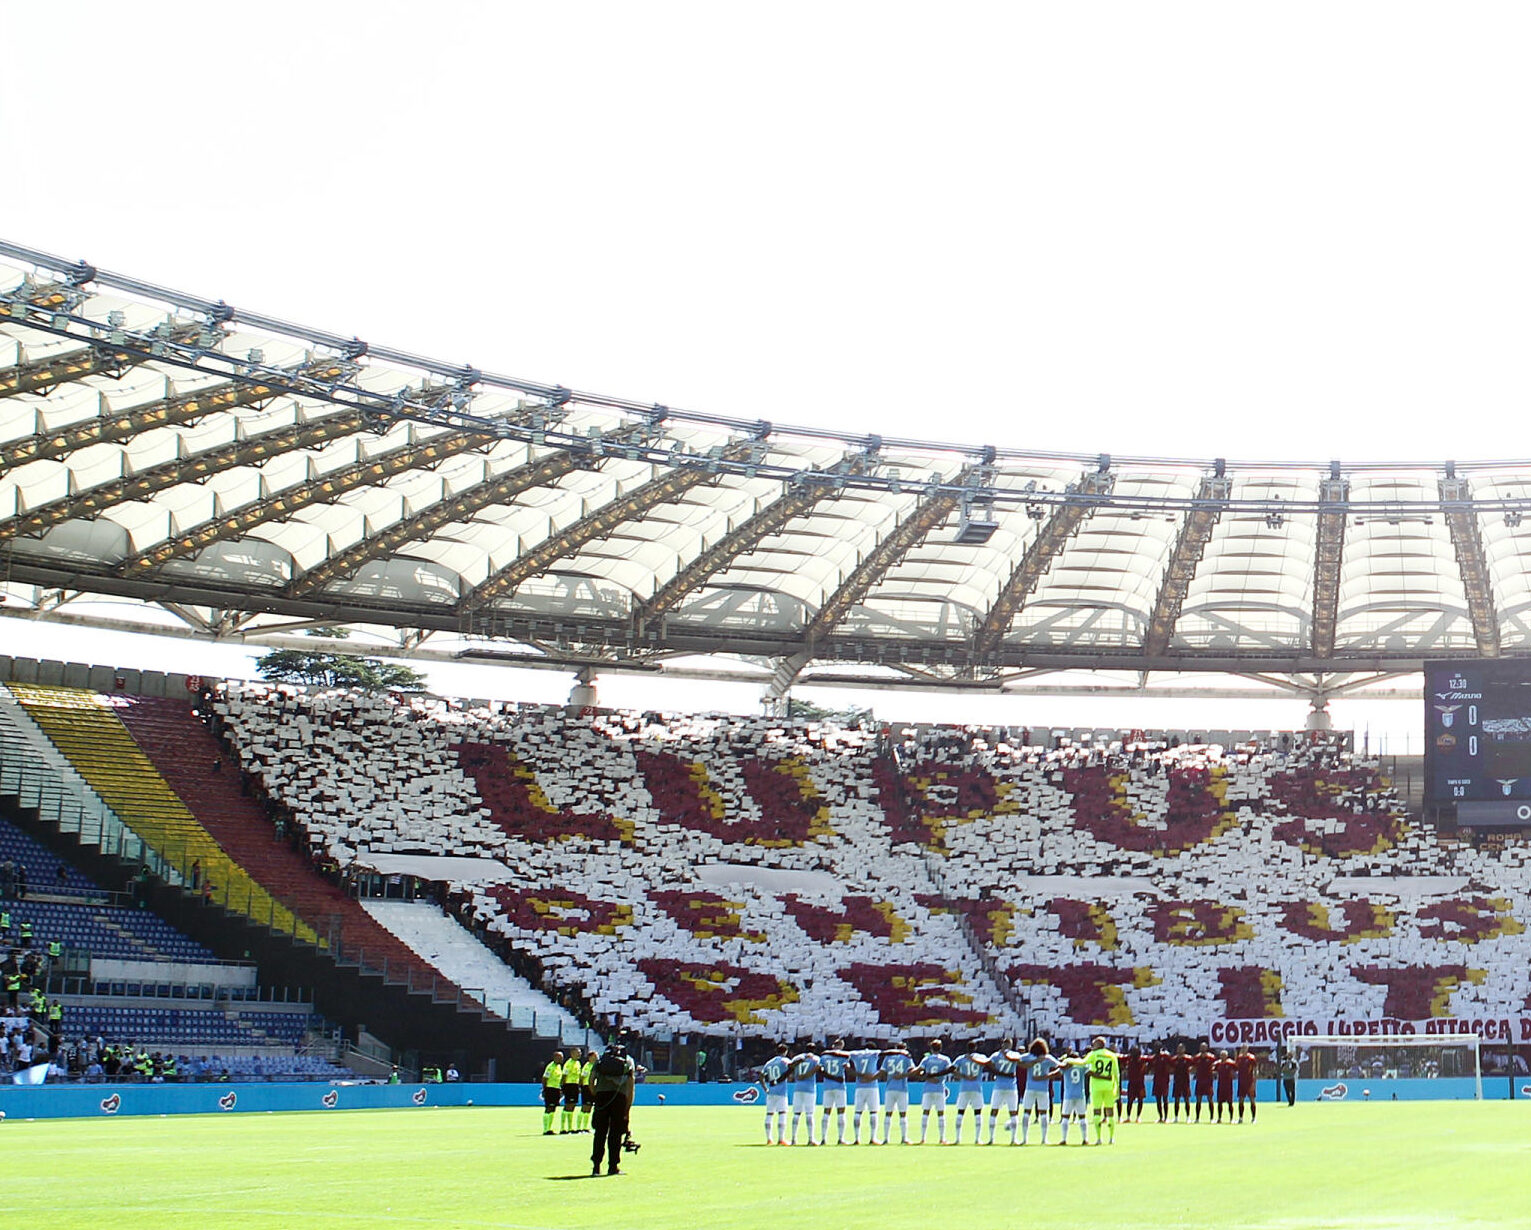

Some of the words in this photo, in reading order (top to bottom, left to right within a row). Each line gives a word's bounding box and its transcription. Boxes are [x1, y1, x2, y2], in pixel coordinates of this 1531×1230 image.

[1469, 704, 1477, 726] 0
[1469, 735, 1477, 756] 0
[450, 742, 1412, 858] LUPUS
[1211, 1020, 1318, 1043] CORAGGIO
[768, 1066, 780, 1081] 10
[826, 1059, 839, 1074] 13
[861, 1058, 869, 1073] 7
[887, 1059, 905, 1075] 34
[965, 1062, 980, 1076] 19
[1033, 1062, 1042, 1076] 8
[1095, 1059, 1113, 1076] 94
[1070, 1068, 1080, 1084] 9
